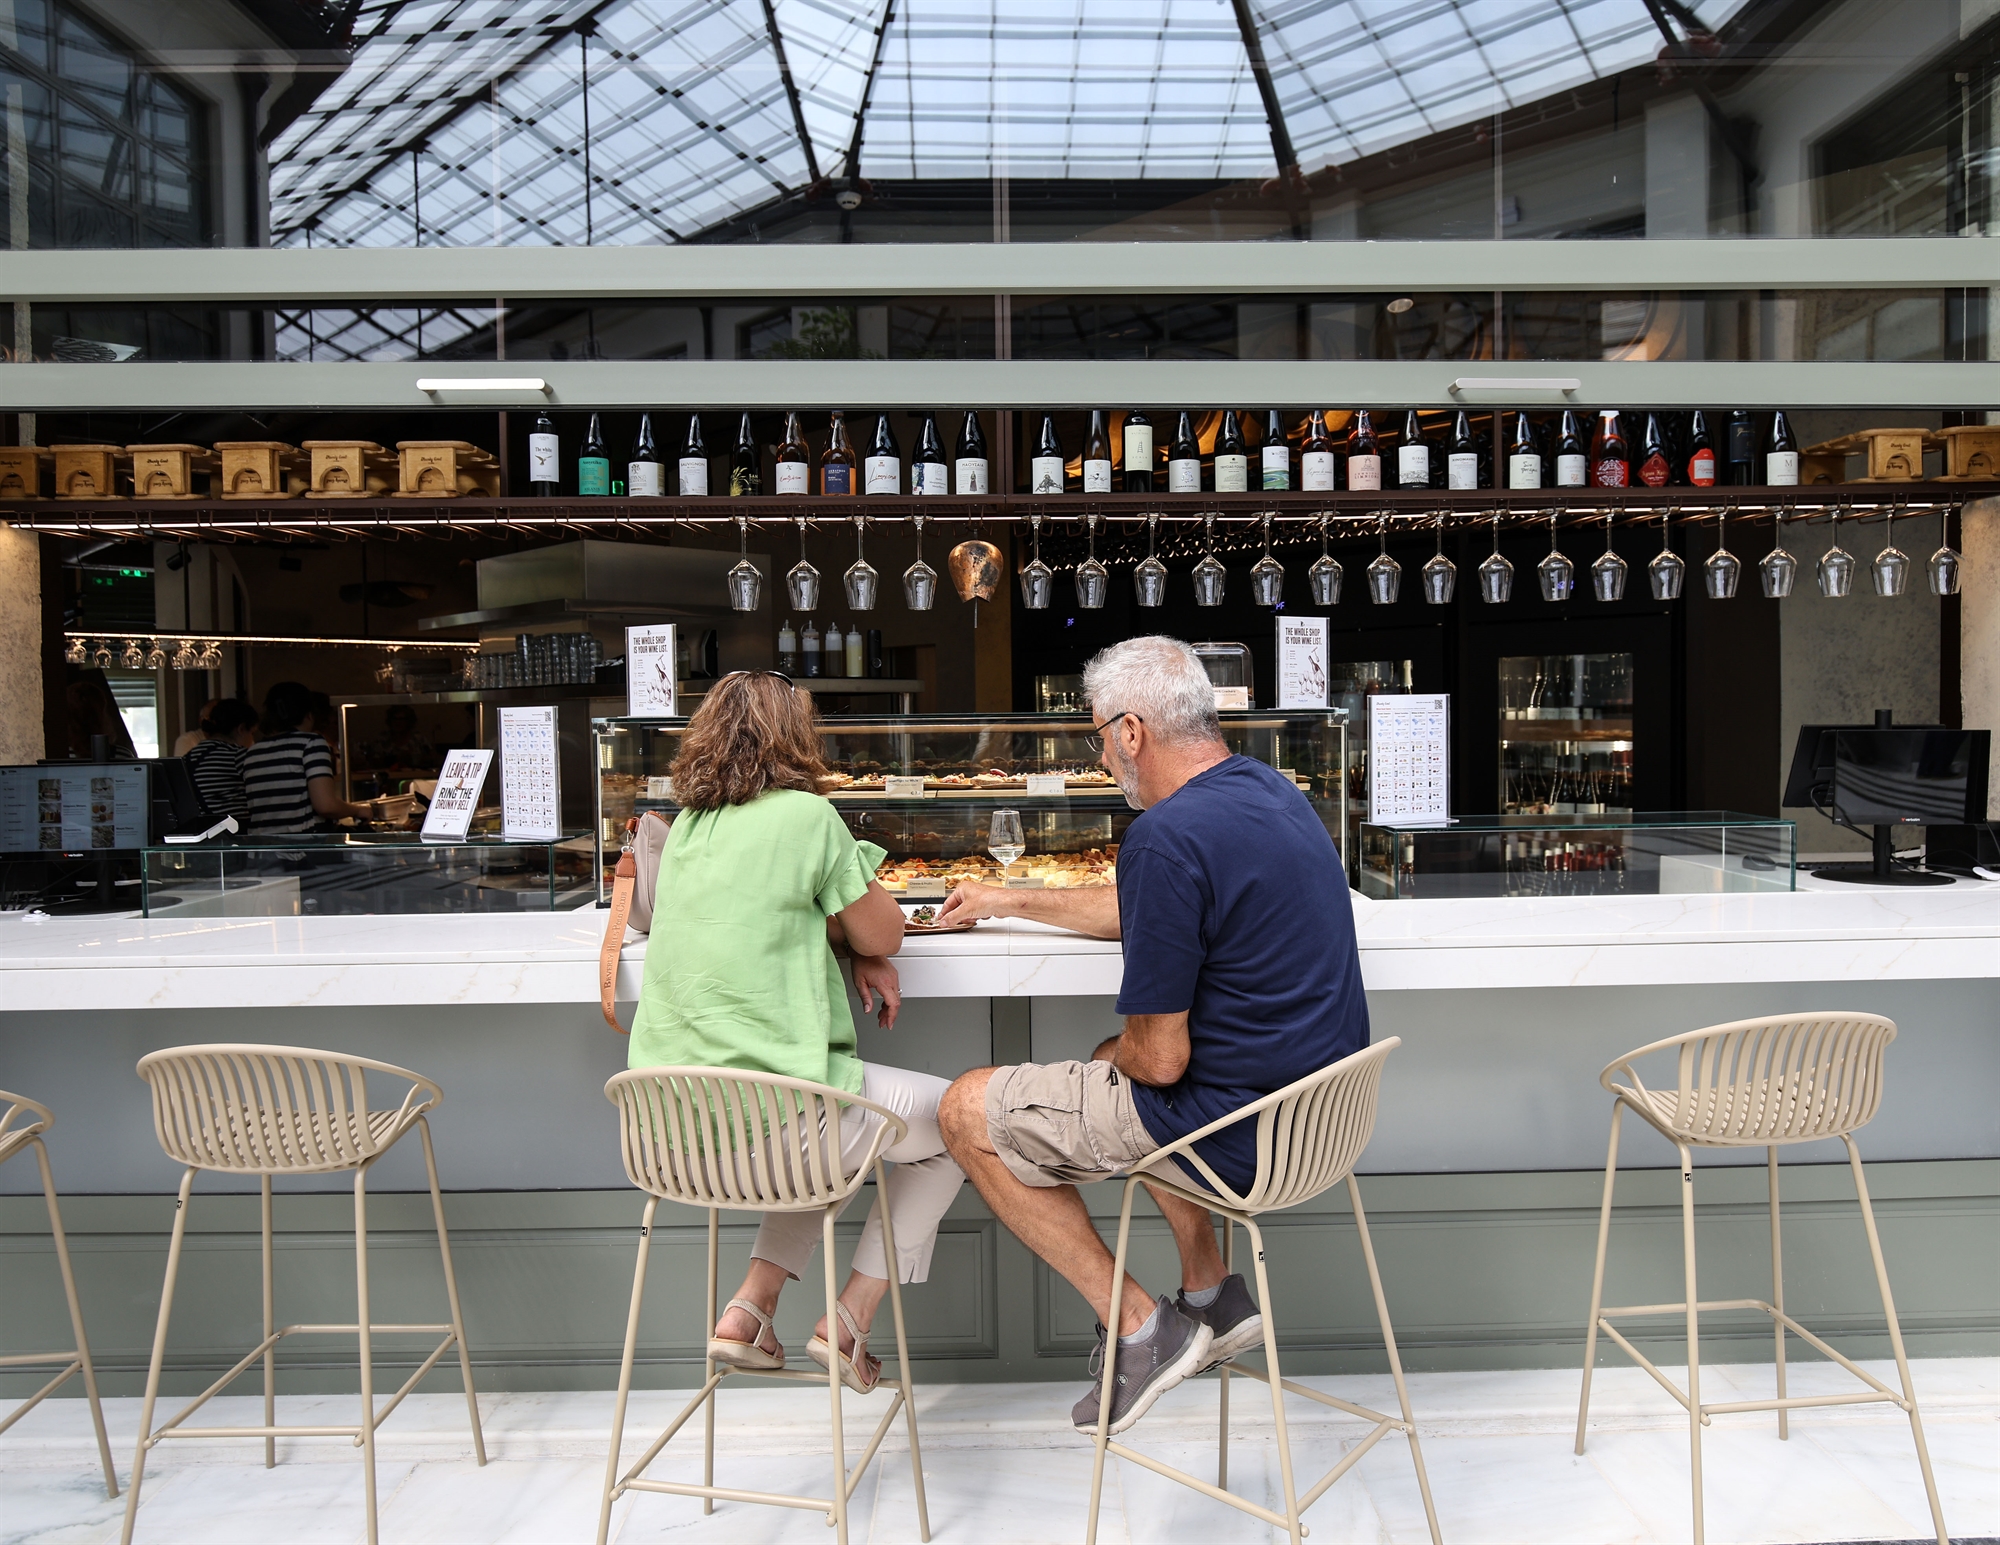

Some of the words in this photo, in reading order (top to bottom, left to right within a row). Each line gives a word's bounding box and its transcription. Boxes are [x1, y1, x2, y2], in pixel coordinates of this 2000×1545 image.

[1285, 627, 1293, 636] THE
[1294, 628, 1308, 636] WHOLE
[1309, 628, 1320, 636] SHOP
[642, 636, 655, 645] WHOLE
[656, 636, 666, 644] SHOP
[1285, 636, 1290, 644] IS
[1290, 637, 1301, 645] YOUR
[1302, 637, 1312, 645] WINE
[1313, 637, 1322, 645] LIST.
[634, 646, 637, 654] IS
[638, 646, 648, 654] YOUR
[649, 645, 658, 653] WINE
[446, 762, 467, 778] LEAVE
[466, 763, 472, 778] A
[470, 763, 482, 778] TIP
[438, 788, 458, 799] RING
[459, 788, 474, 799] THE
[435, 799, 457, 809] DRUNKY
[457, 800, 469, 810] BELL
